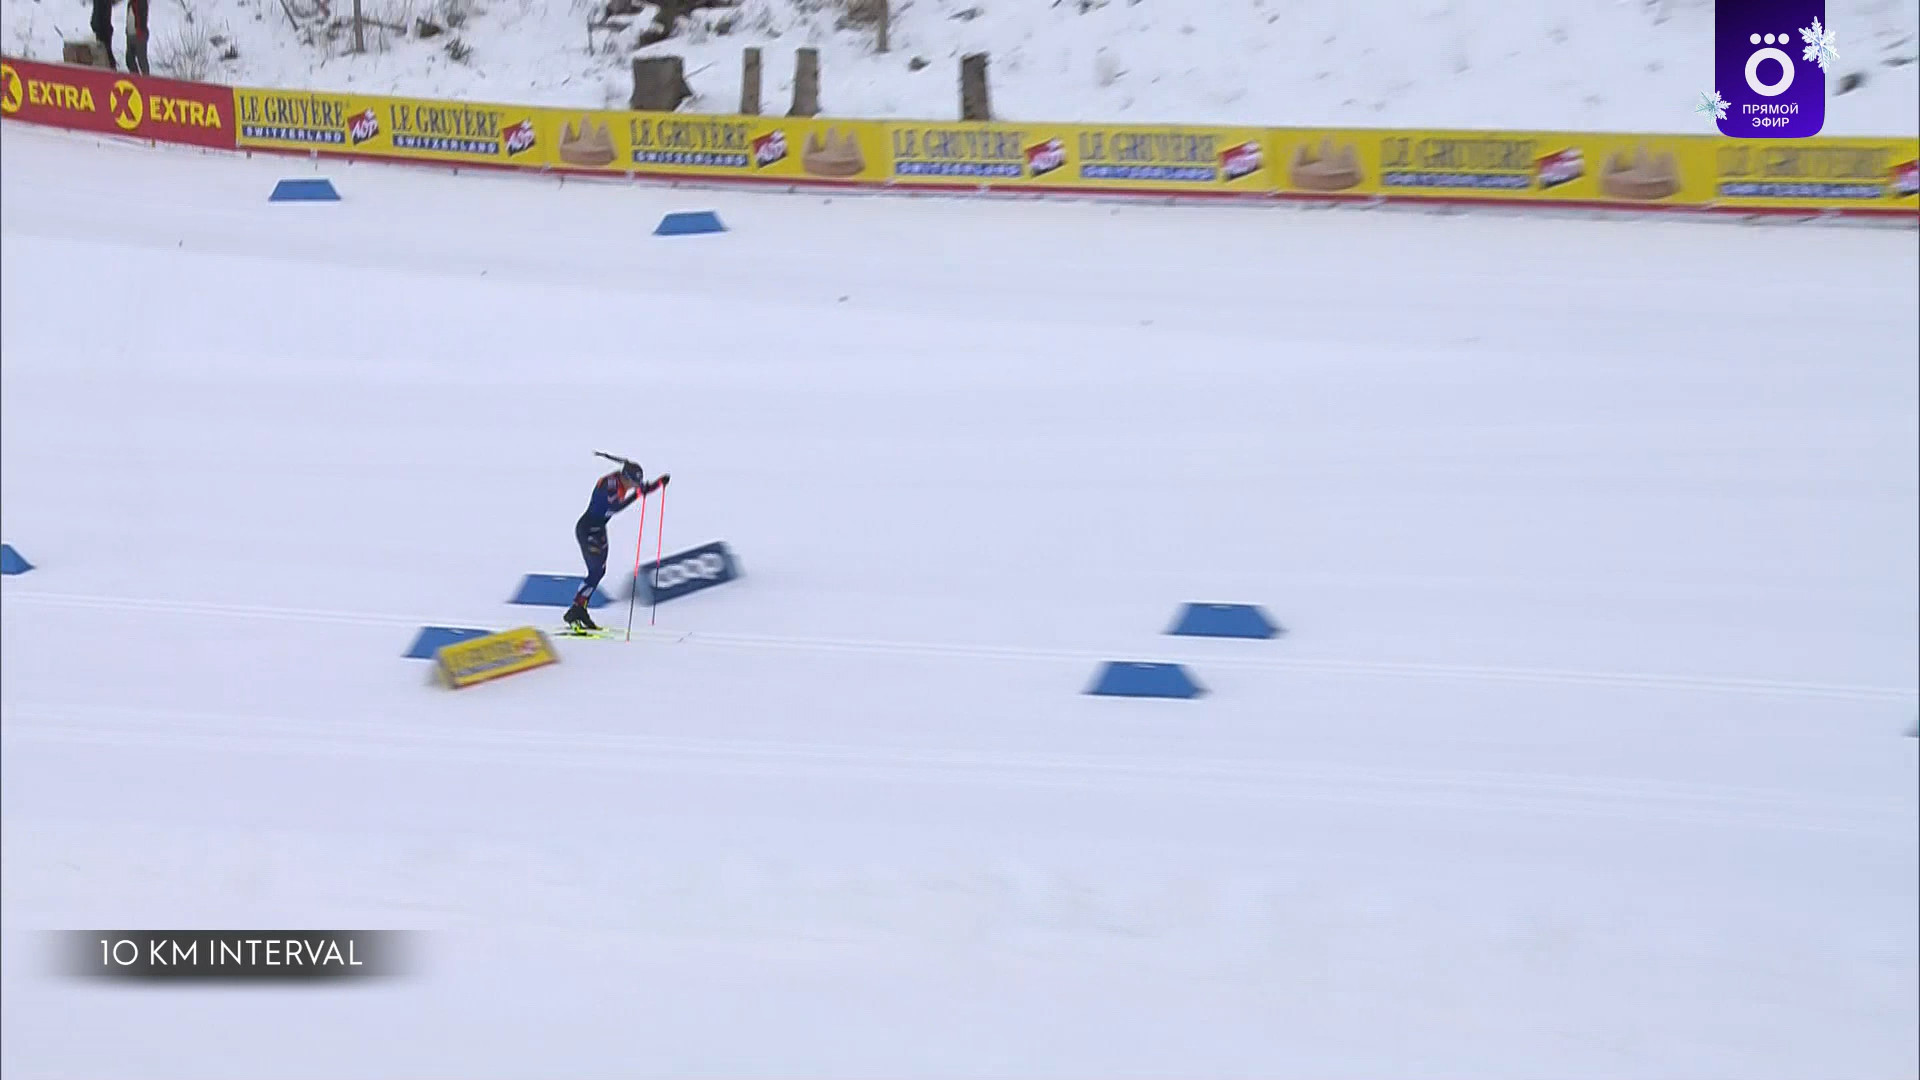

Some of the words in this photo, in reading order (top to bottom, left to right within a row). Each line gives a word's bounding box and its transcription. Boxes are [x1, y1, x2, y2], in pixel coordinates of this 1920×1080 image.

[28, 79, 96, 112] EXTRA
[150, 95, 222, 129] EXTRA
[239, 95, 261, 122] LE
[264, 94, 345, 128] GRUYÈRE
[390, 104, 412, 131] LE
[245, 126, 342, 143] SWITZERLAND
